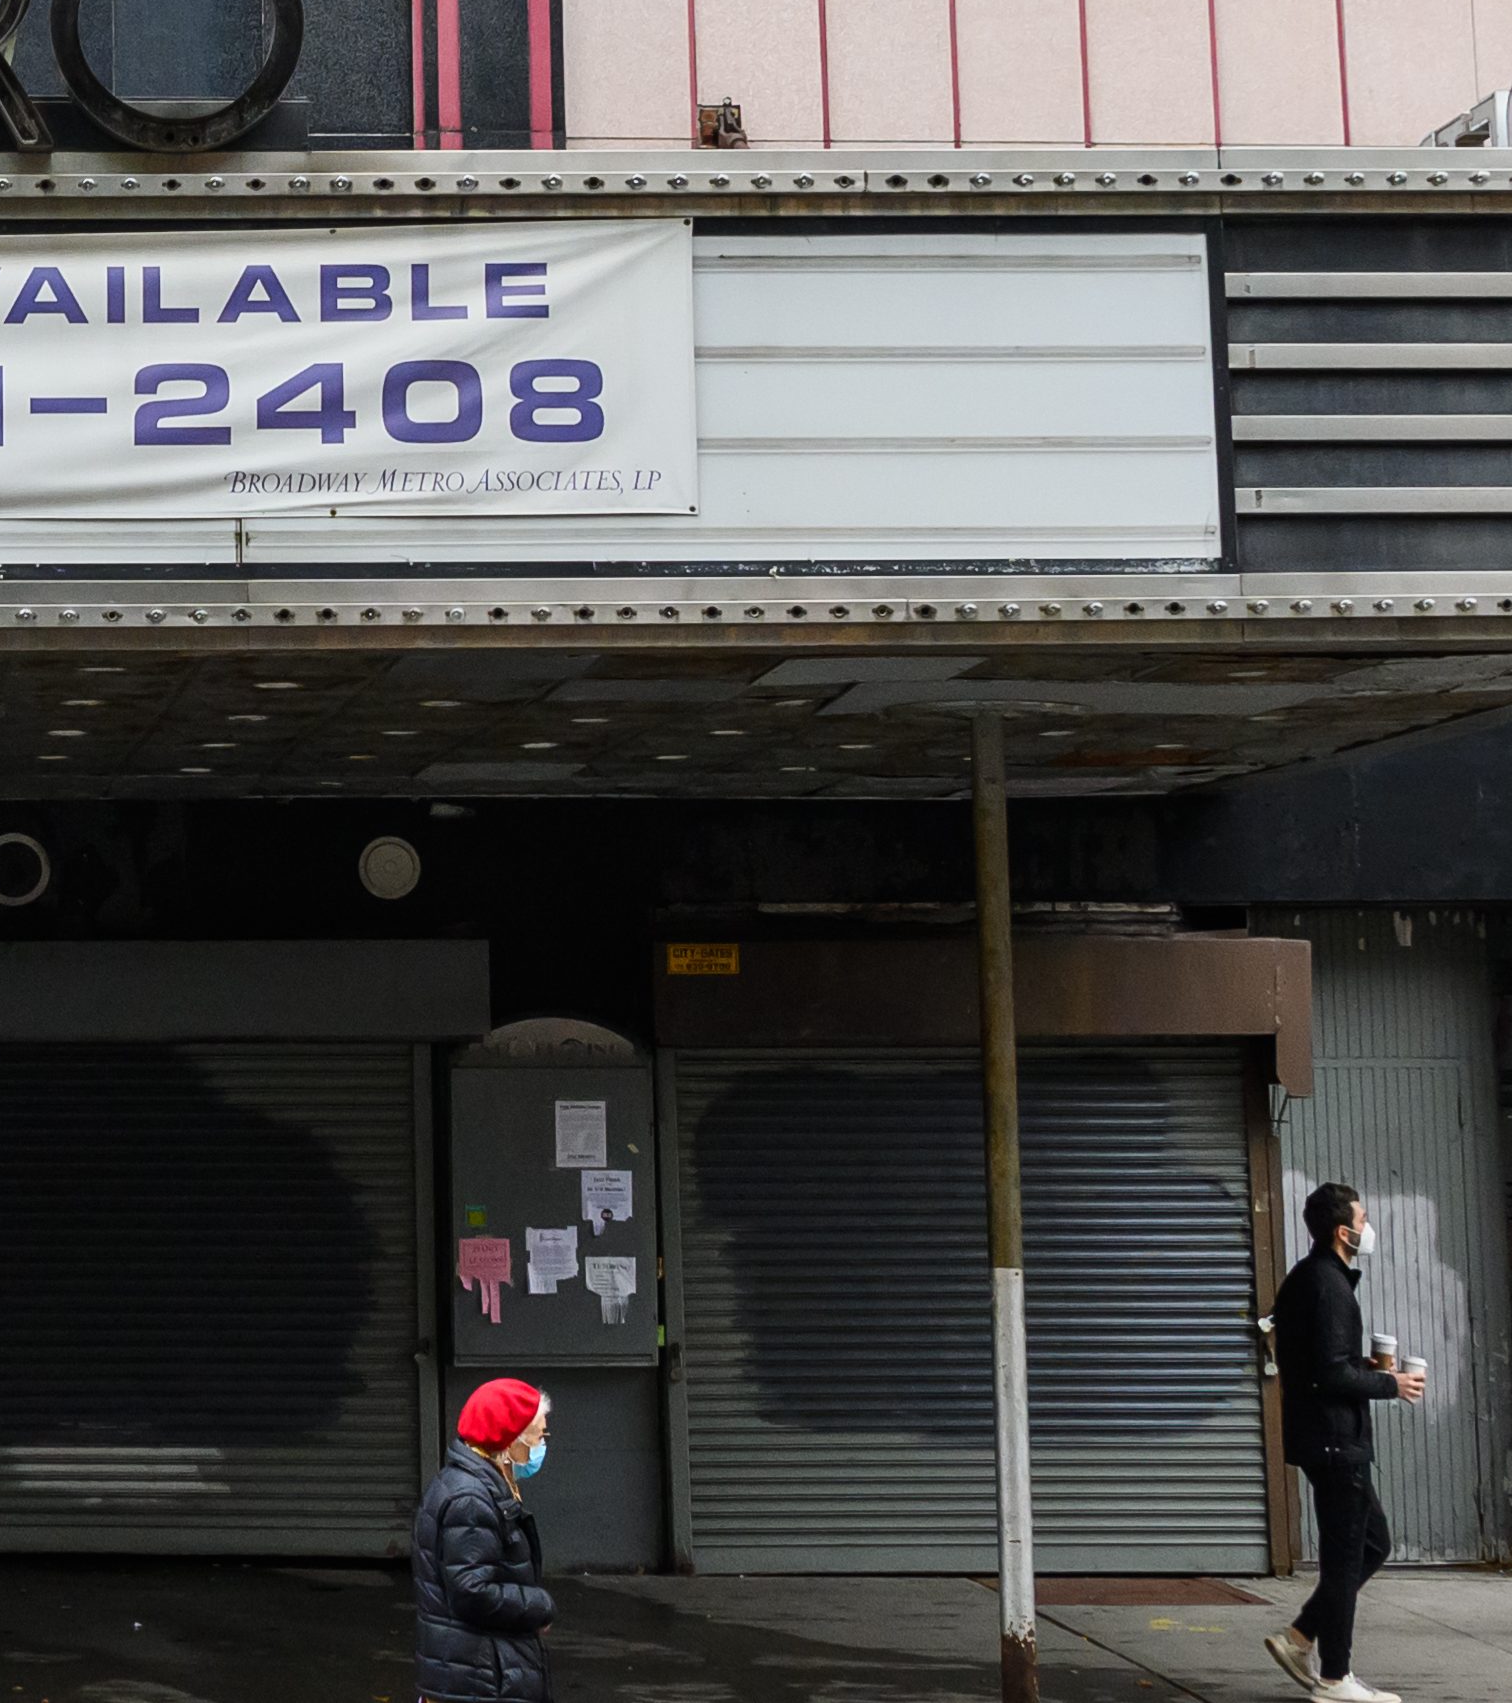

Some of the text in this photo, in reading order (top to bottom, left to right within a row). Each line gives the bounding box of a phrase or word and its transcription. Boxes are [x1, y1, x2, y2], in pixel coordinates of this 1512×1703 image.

[224, 469, 662, 497] BROADWAY METRO ASSOCIATES, LP
